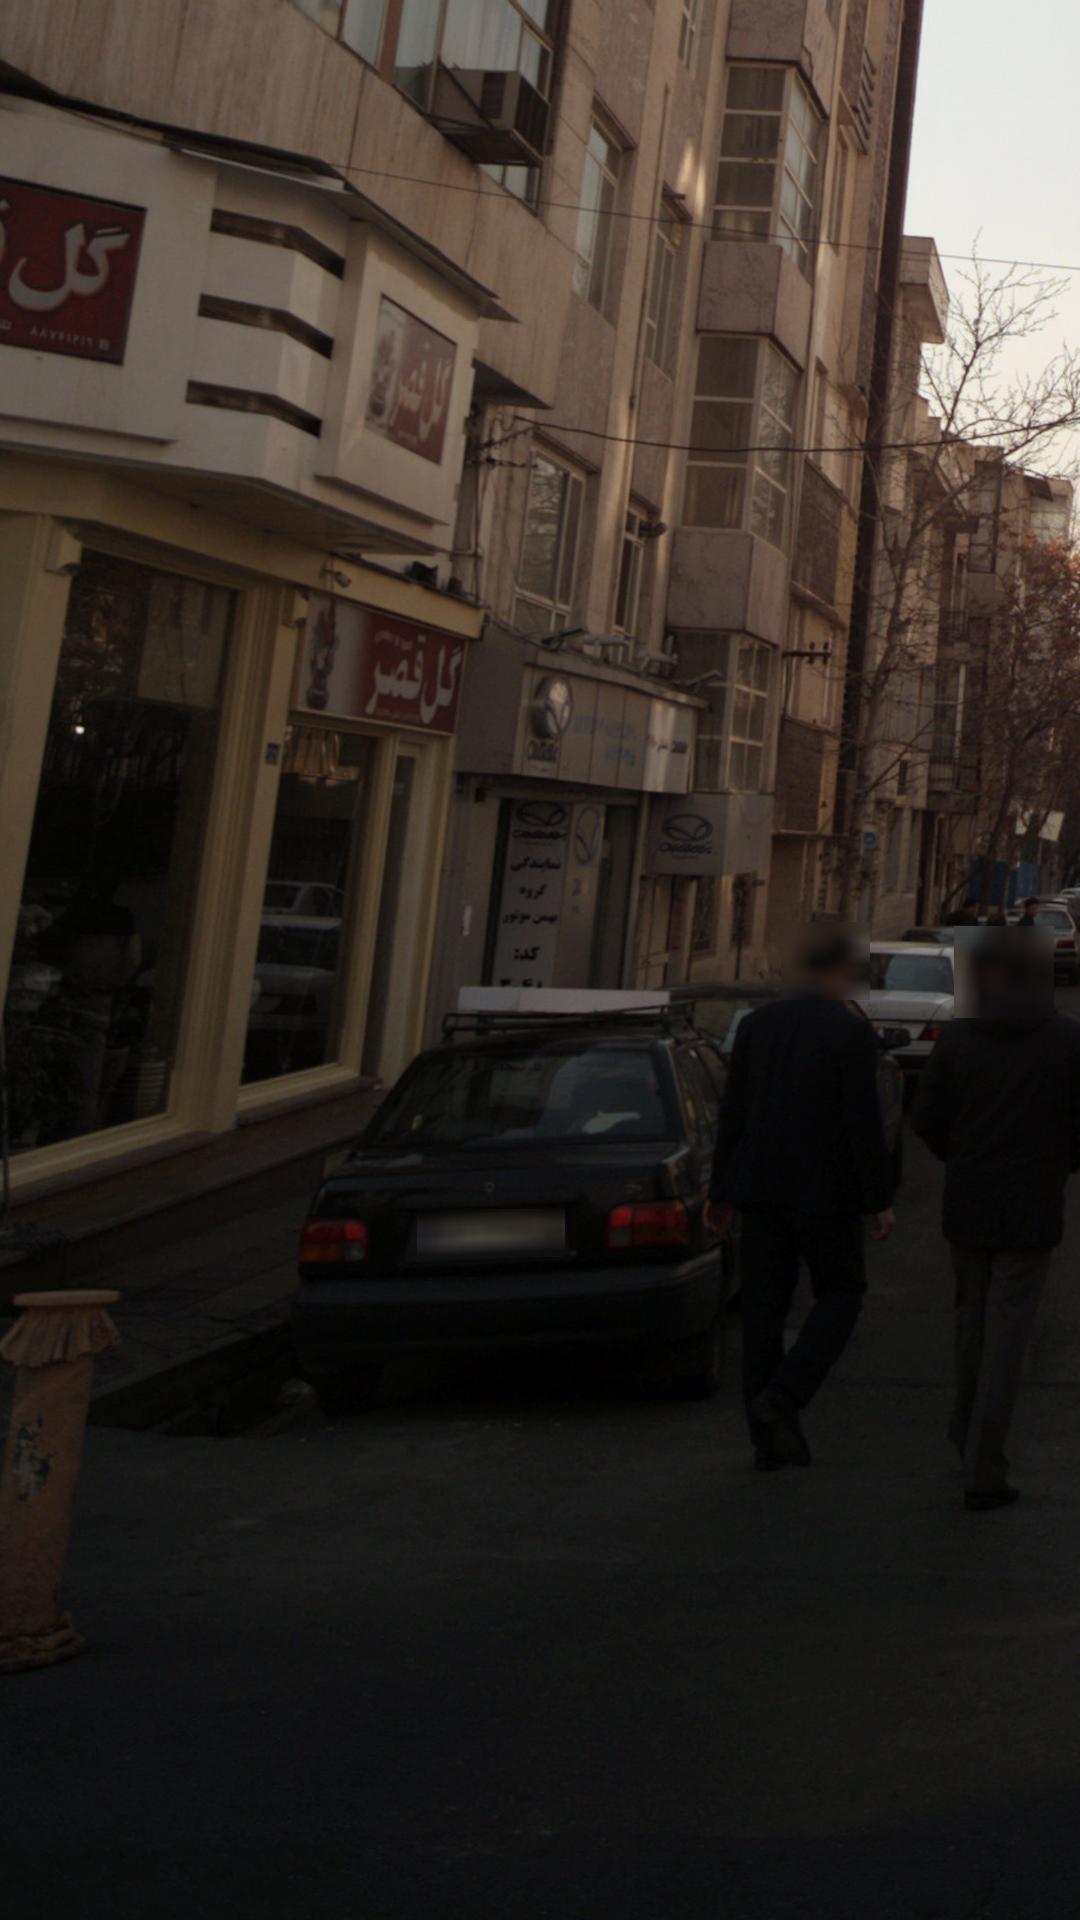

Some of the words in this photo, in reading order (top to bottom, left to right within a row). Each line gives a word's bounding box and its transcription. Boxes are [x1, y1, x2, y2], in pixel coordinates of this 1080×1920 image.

[9, 222, 131, 313] گل
[365, 632, 427, 715] قصر
[420, 645, 463, 725] گل
